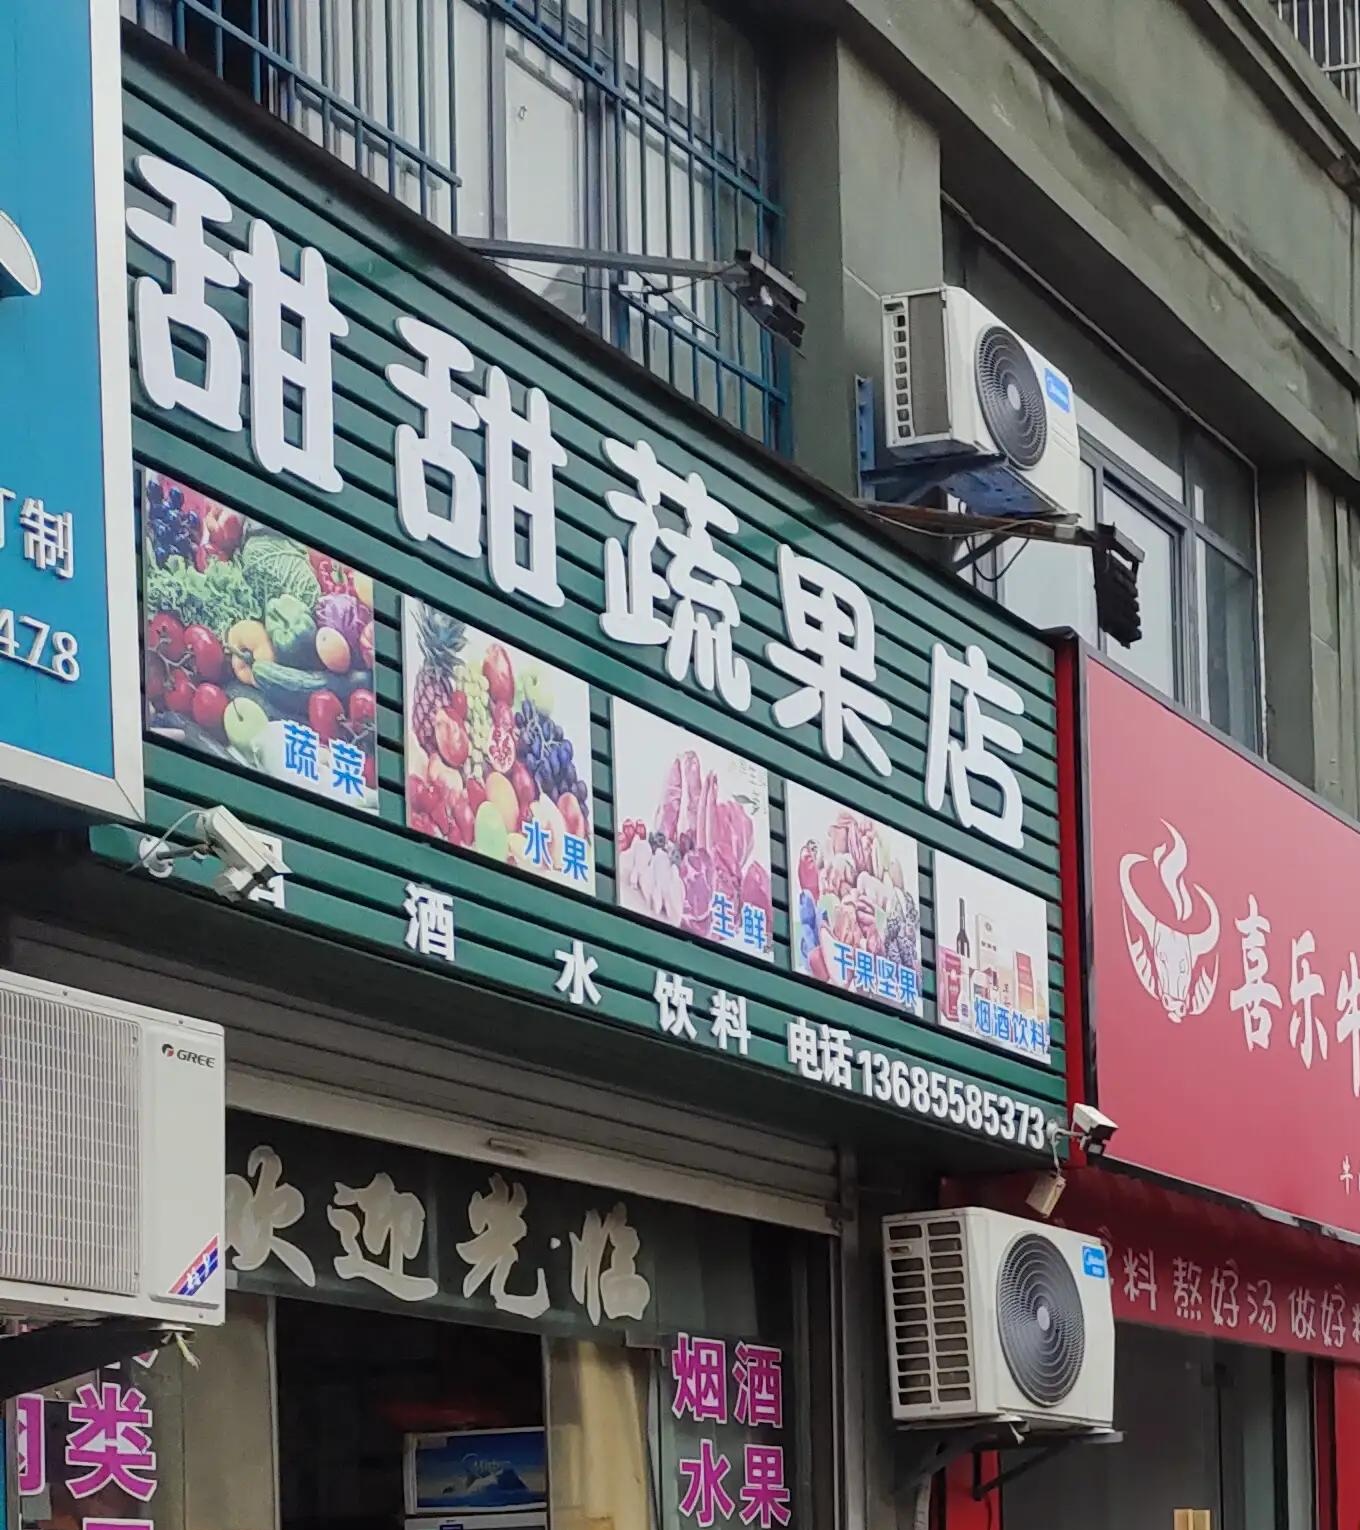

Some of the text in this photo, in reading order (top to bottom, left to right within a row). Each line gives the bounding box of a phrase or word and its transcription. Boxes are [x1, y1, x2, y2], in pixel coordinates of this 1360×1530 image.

[126, 154, 1024, 850] 甜甜蔬果店
[283, 720, 365, 798] 蔬菜
[523, 821, 589, 882] 水果
[712, 893, 767, 949] 生鲜
[833, 942, 918, 1005] 干果坚果
[176, 1048, 216, 1069] GREE
[973, 995, 1046, 1054] 烟酒饮料
[1172, 1256, 1277, 1334] 熬好汤
[671, 1332, 784, 1429] 烟酒
[678, 1438, 793, 1530] 水果
